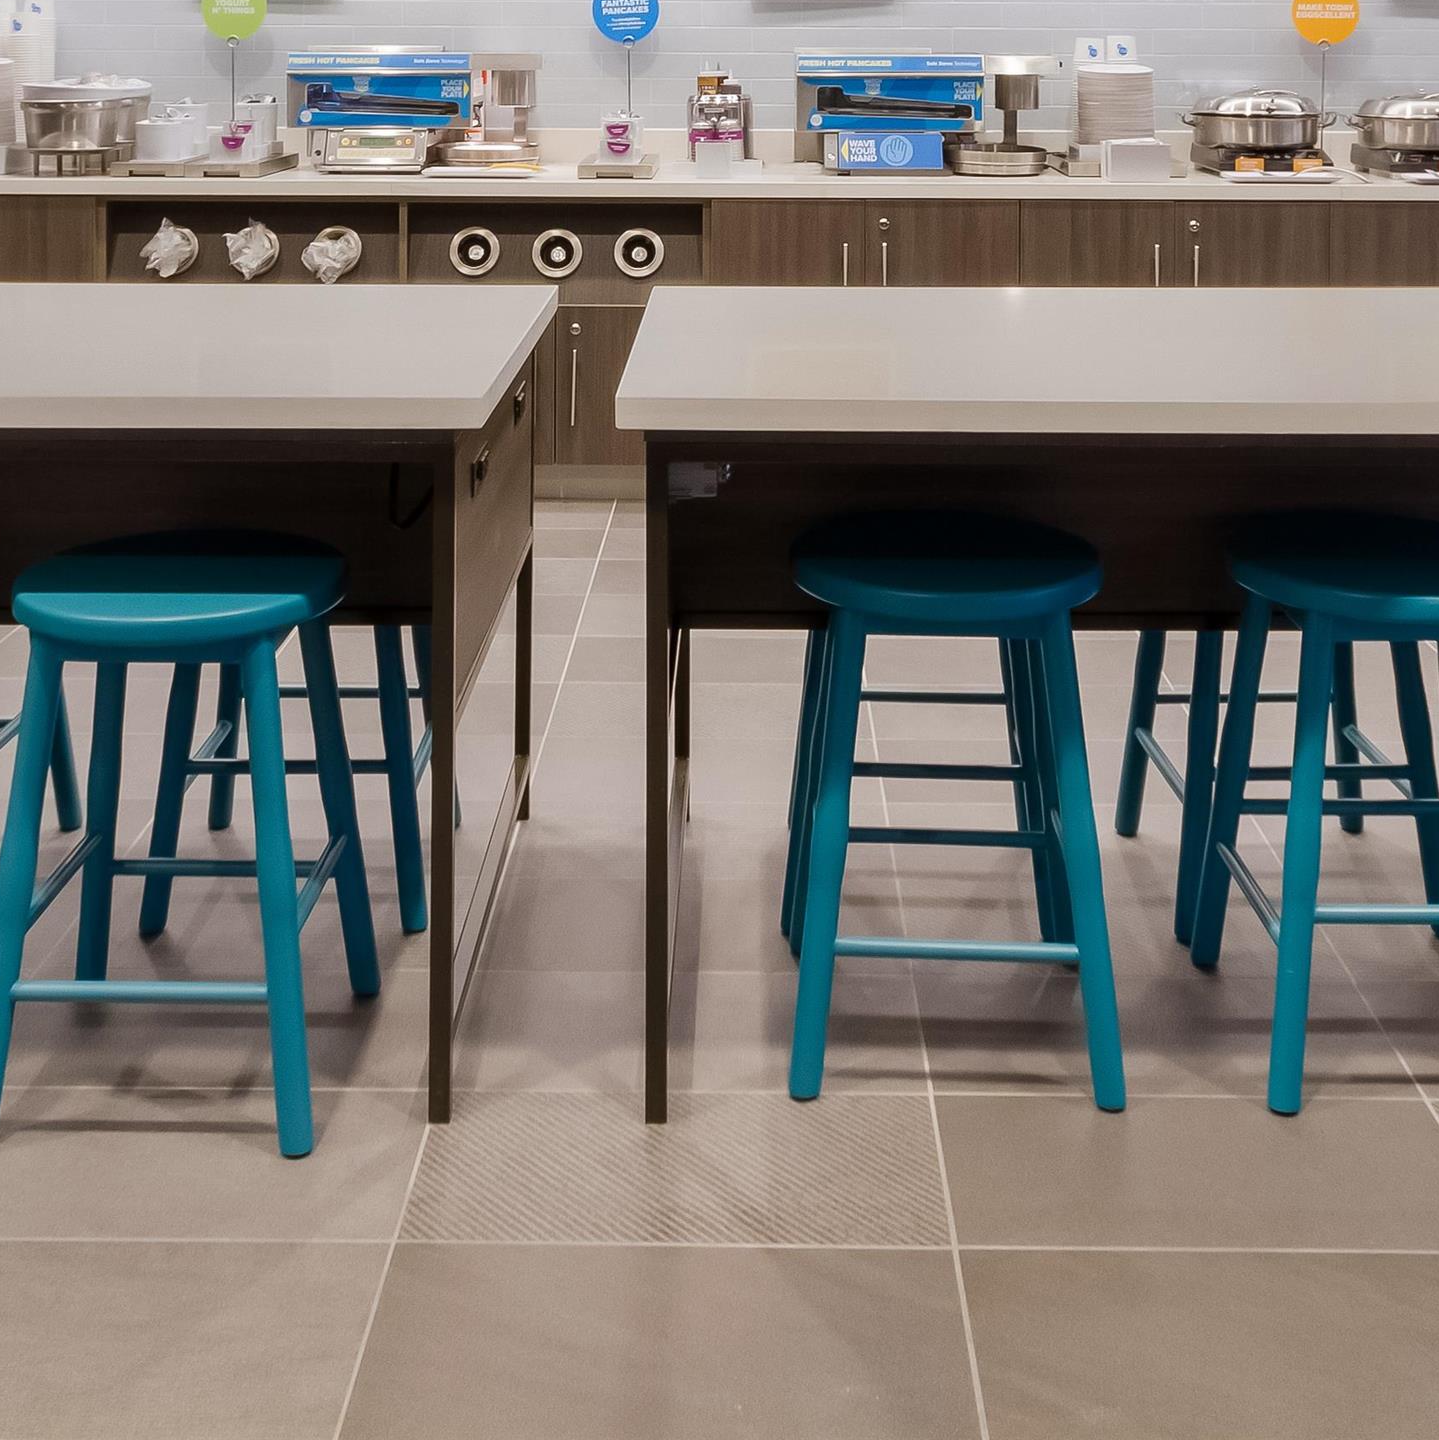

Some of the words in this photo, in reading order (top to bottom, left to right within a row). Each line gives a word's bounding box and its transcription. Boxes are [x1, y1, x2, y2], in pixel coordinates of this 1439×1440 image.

[602, 6, 649, 15] PANCAKES
[288, 57, 315, 65] FRESH
[317, 57, 335, 65] HOT
[336, 57, 380, 65] PANCAKES
[849, 139, 876, 147] WAVE
[850, 154, 878, 162] HAND
